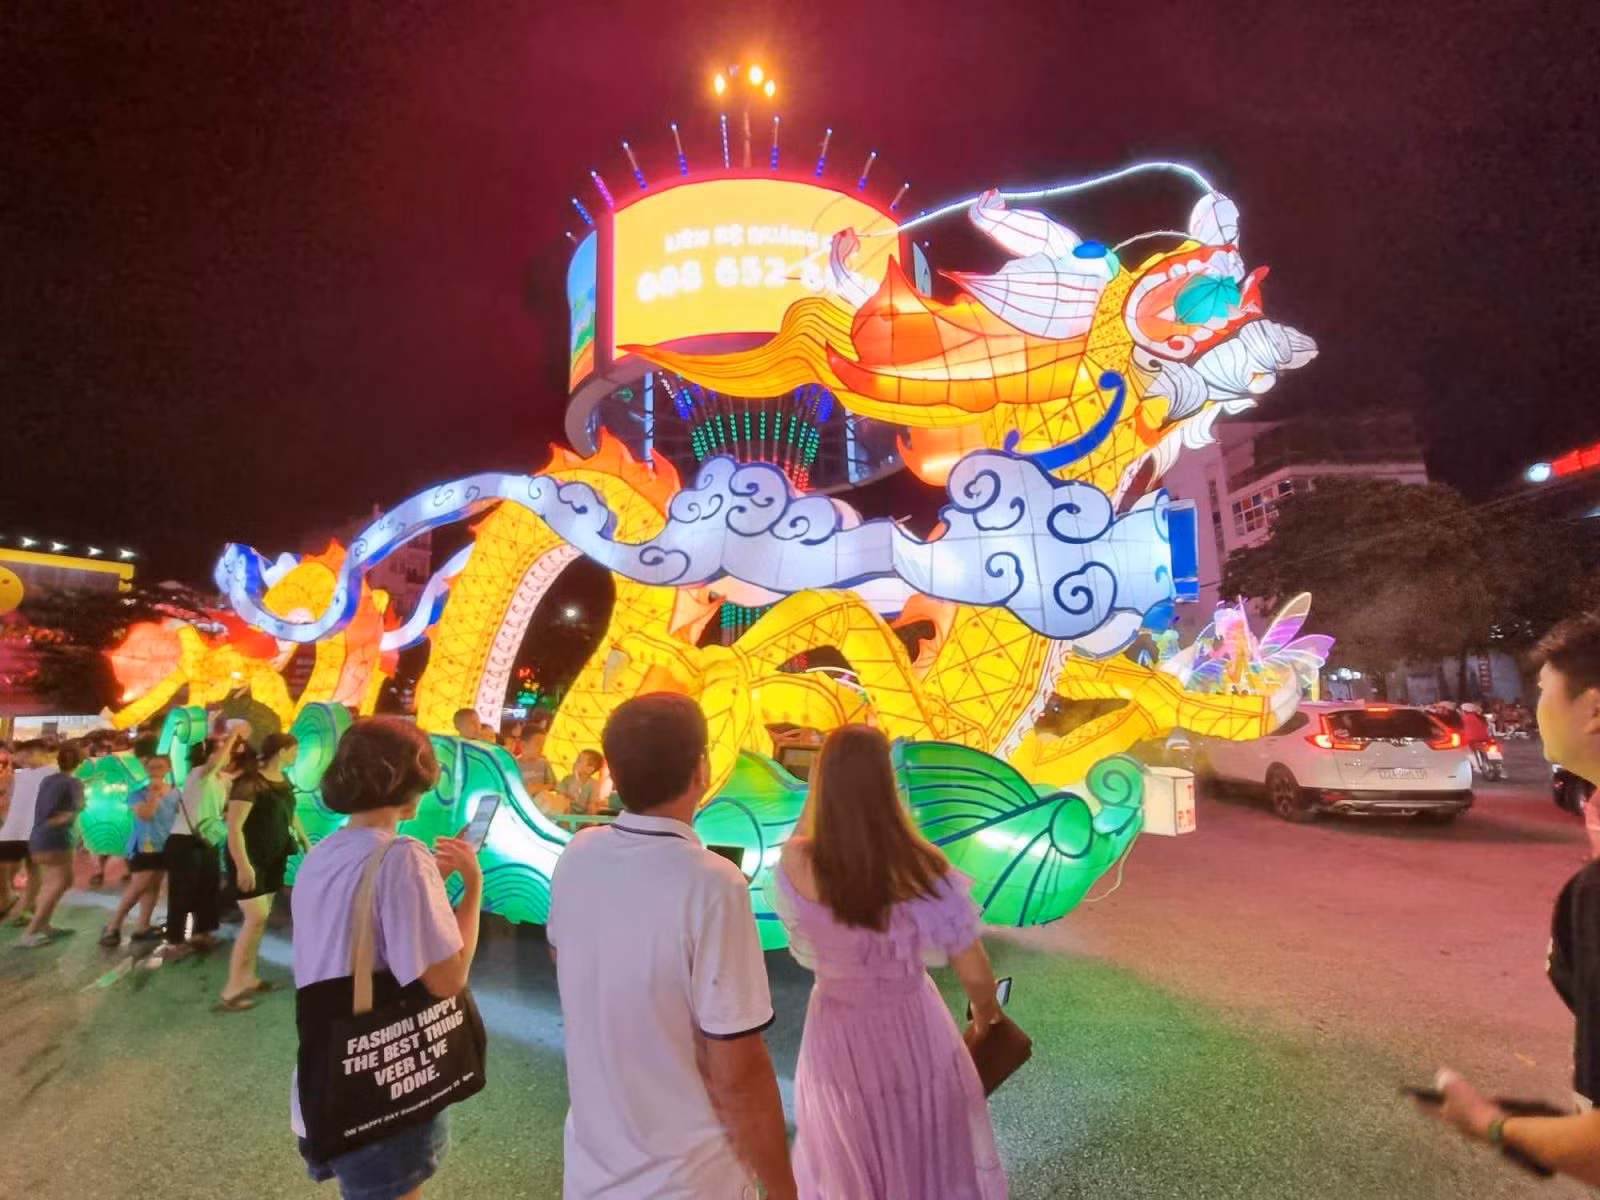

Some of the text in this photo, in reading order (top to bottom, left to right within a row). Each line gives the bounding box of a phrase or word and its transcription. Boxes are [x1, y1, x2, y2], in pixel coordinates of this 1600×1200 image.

[341, 1010, 464, 1075] THE BEST THING
[347, 996, 457, 1055] FASHION HAPPY
[374, 1057, 416, 1086] VEER
[390, 1064, 440, 1100] DONE.
